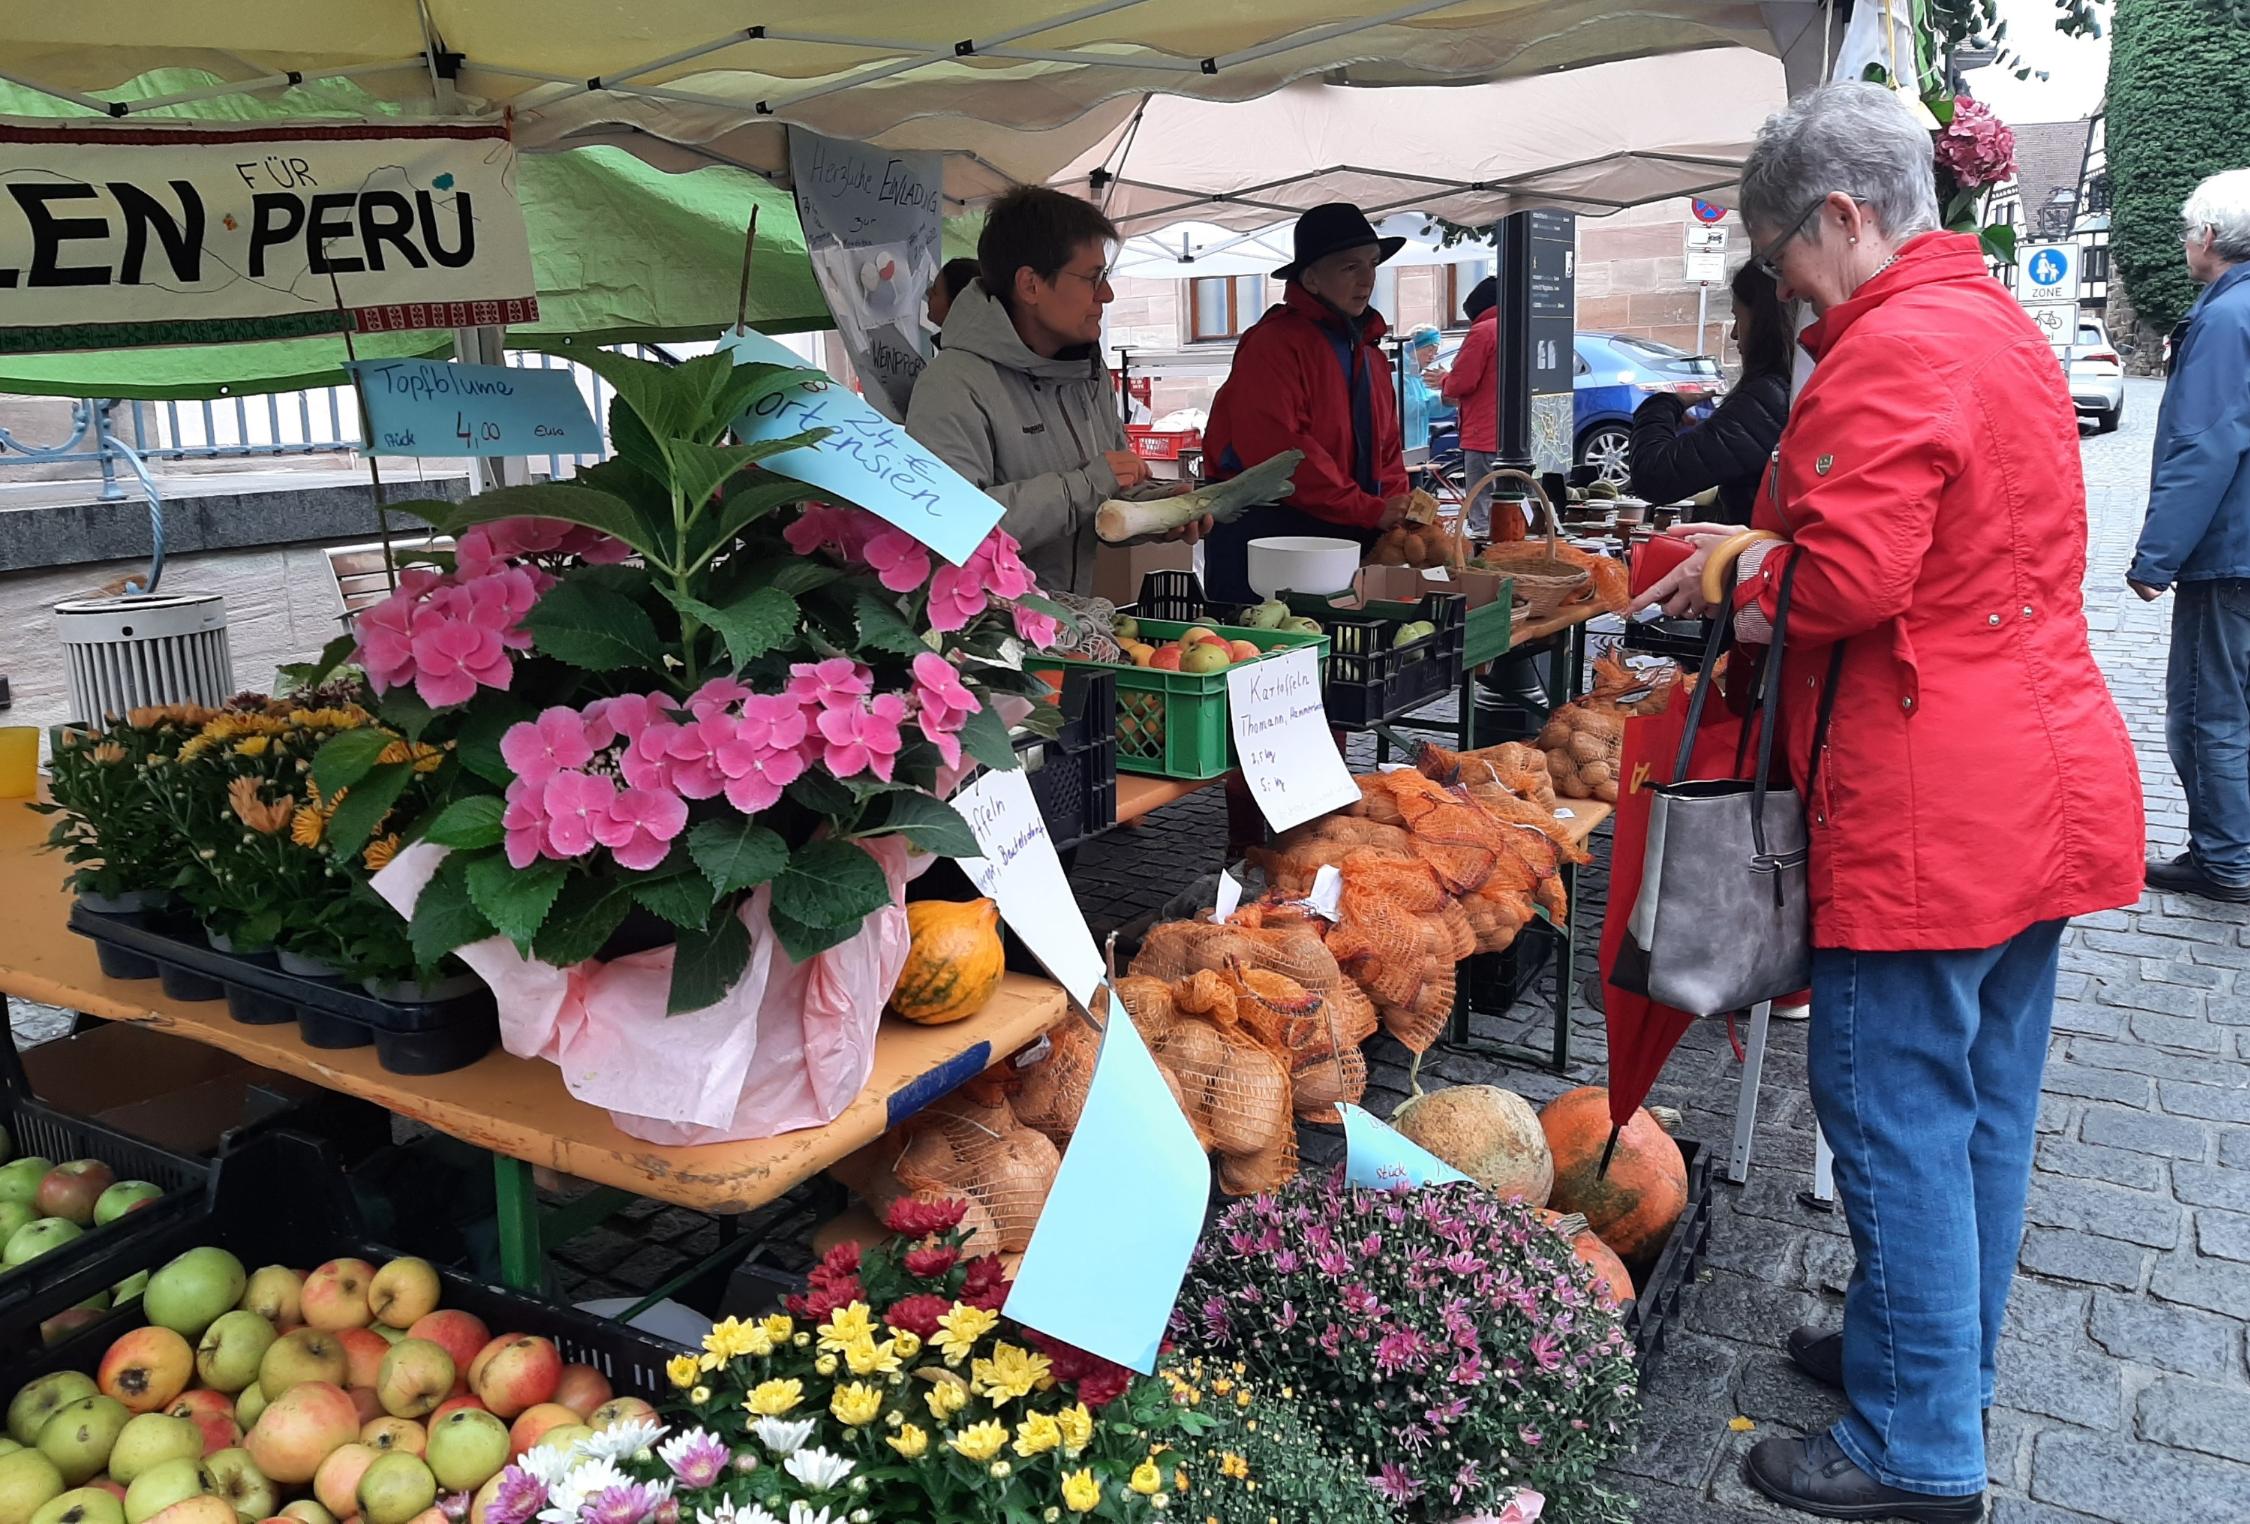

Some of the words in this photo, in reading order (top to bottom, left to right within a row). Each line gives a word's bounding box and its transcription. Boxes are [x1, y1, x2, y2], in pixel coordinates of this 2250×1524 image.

[235, 156, 319, 190] FÜR
[0, 180, 206, 289] EN
[248, 190, 477, 278] PERU
[2031, 287, 2063, 298] ZONE
[374, 363, 514, 402] Topfblume
[456, 410, 501, 449] 4,00
[533, 424, 565, 438] Euro
[843, 410, 899, 450] 24
[905, 453, 942, 485] €
[1249, 671, 1311, 704] Kartoffeln
